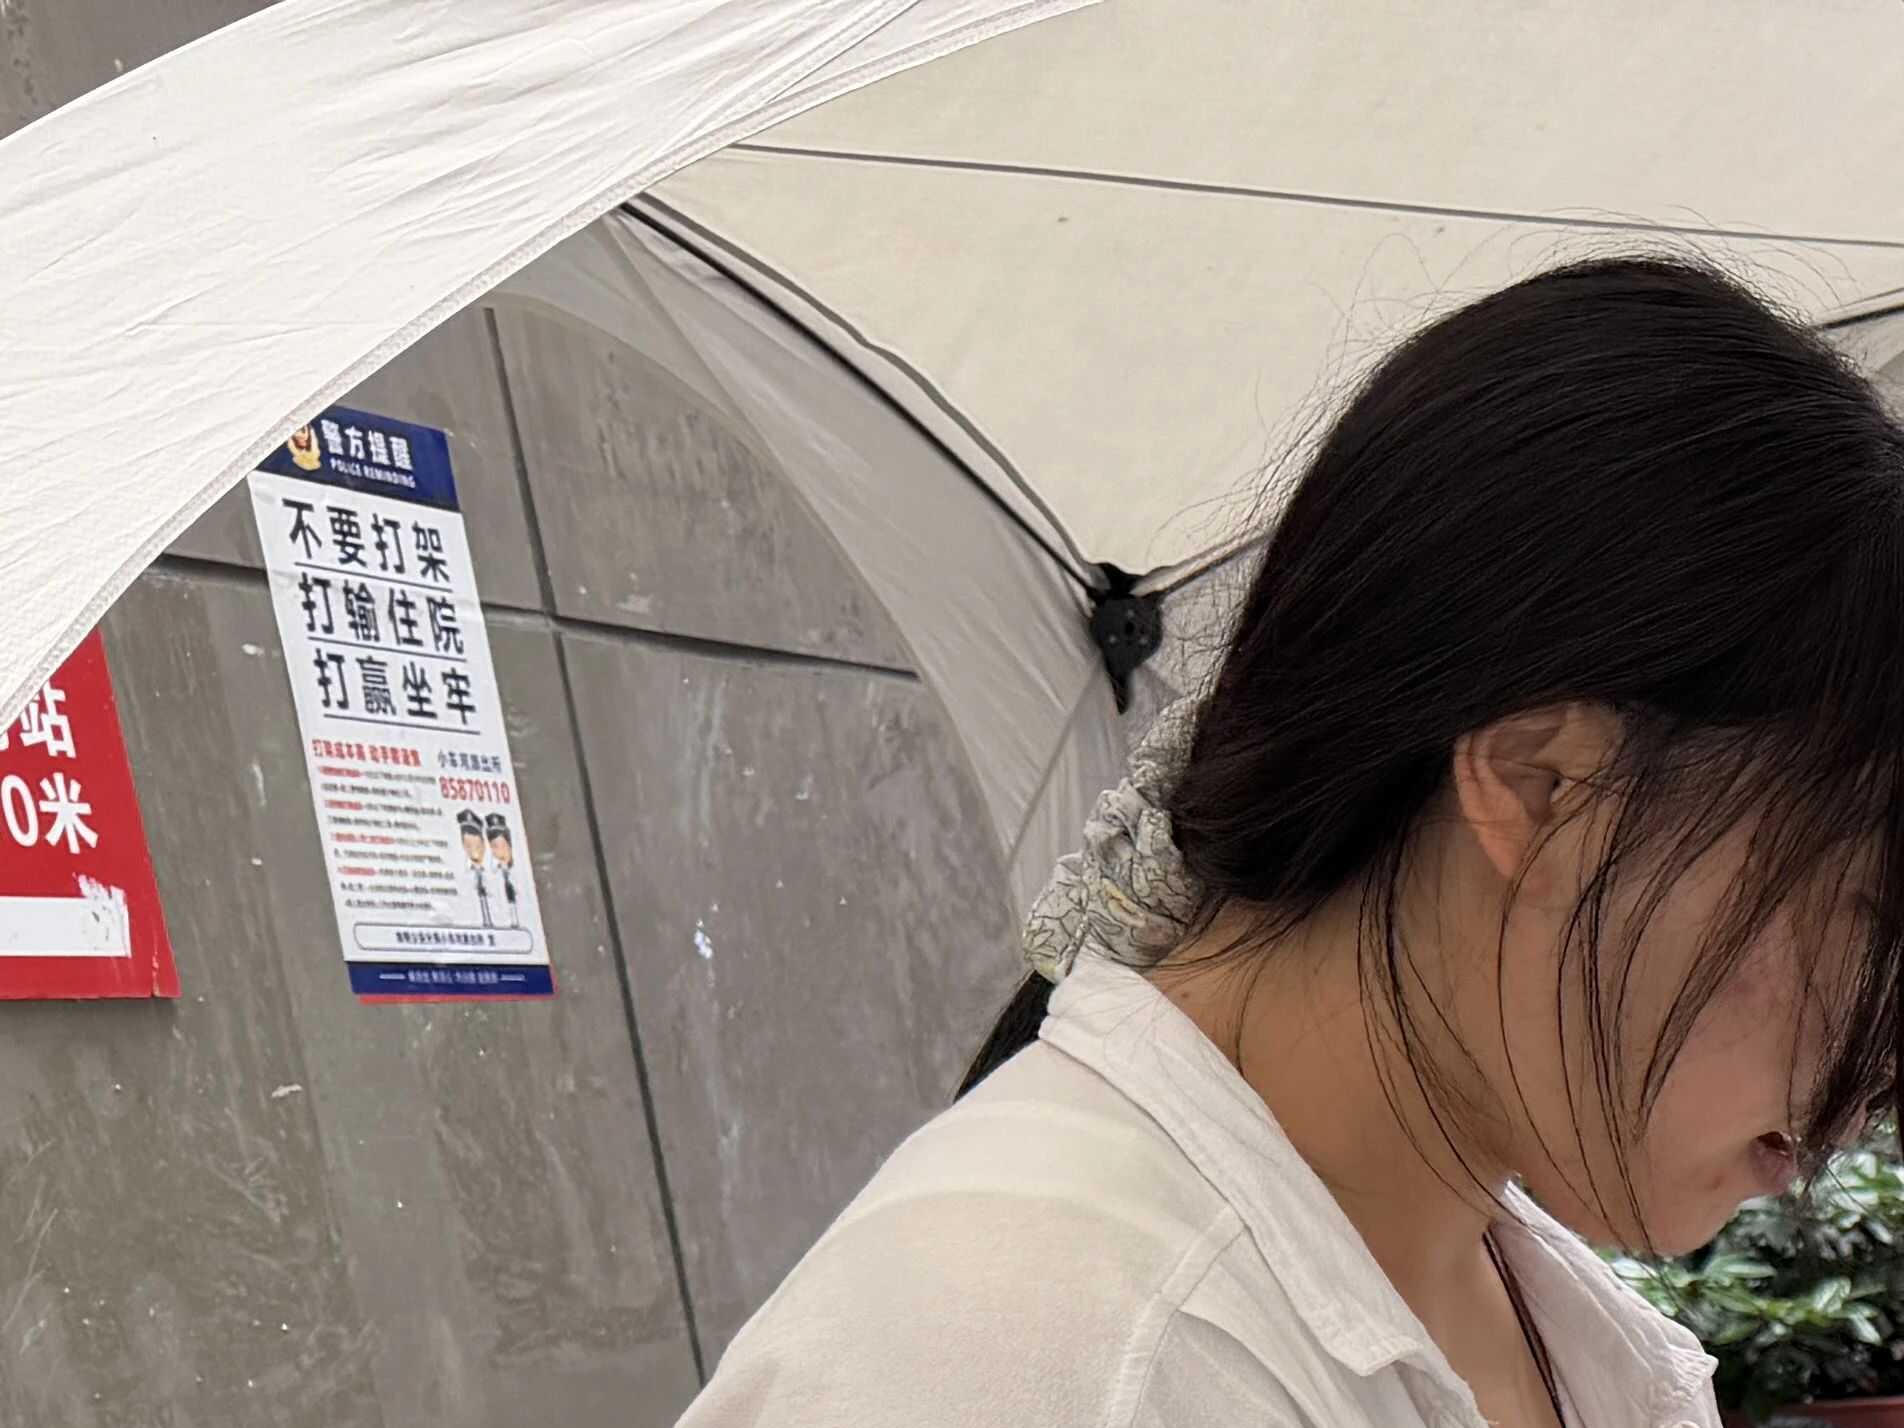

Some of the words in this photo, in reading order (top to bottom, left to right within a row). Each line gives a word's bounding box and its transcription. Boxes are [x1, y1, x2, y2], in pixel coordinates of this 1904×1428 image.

[321, 418, 413, 471] 警方提醒
[330, 458, 363, 477] POLICE
[364, 464, 416, 488] REMINDING
[281, 498, 450, 582] 不要打架
[300, 573, 465, 654] 打输住院
[0, 680, 75, 760] 站
[316, 648, 476, 725] 打赢坐牢
[439, 775, 511, 804] 85870110
